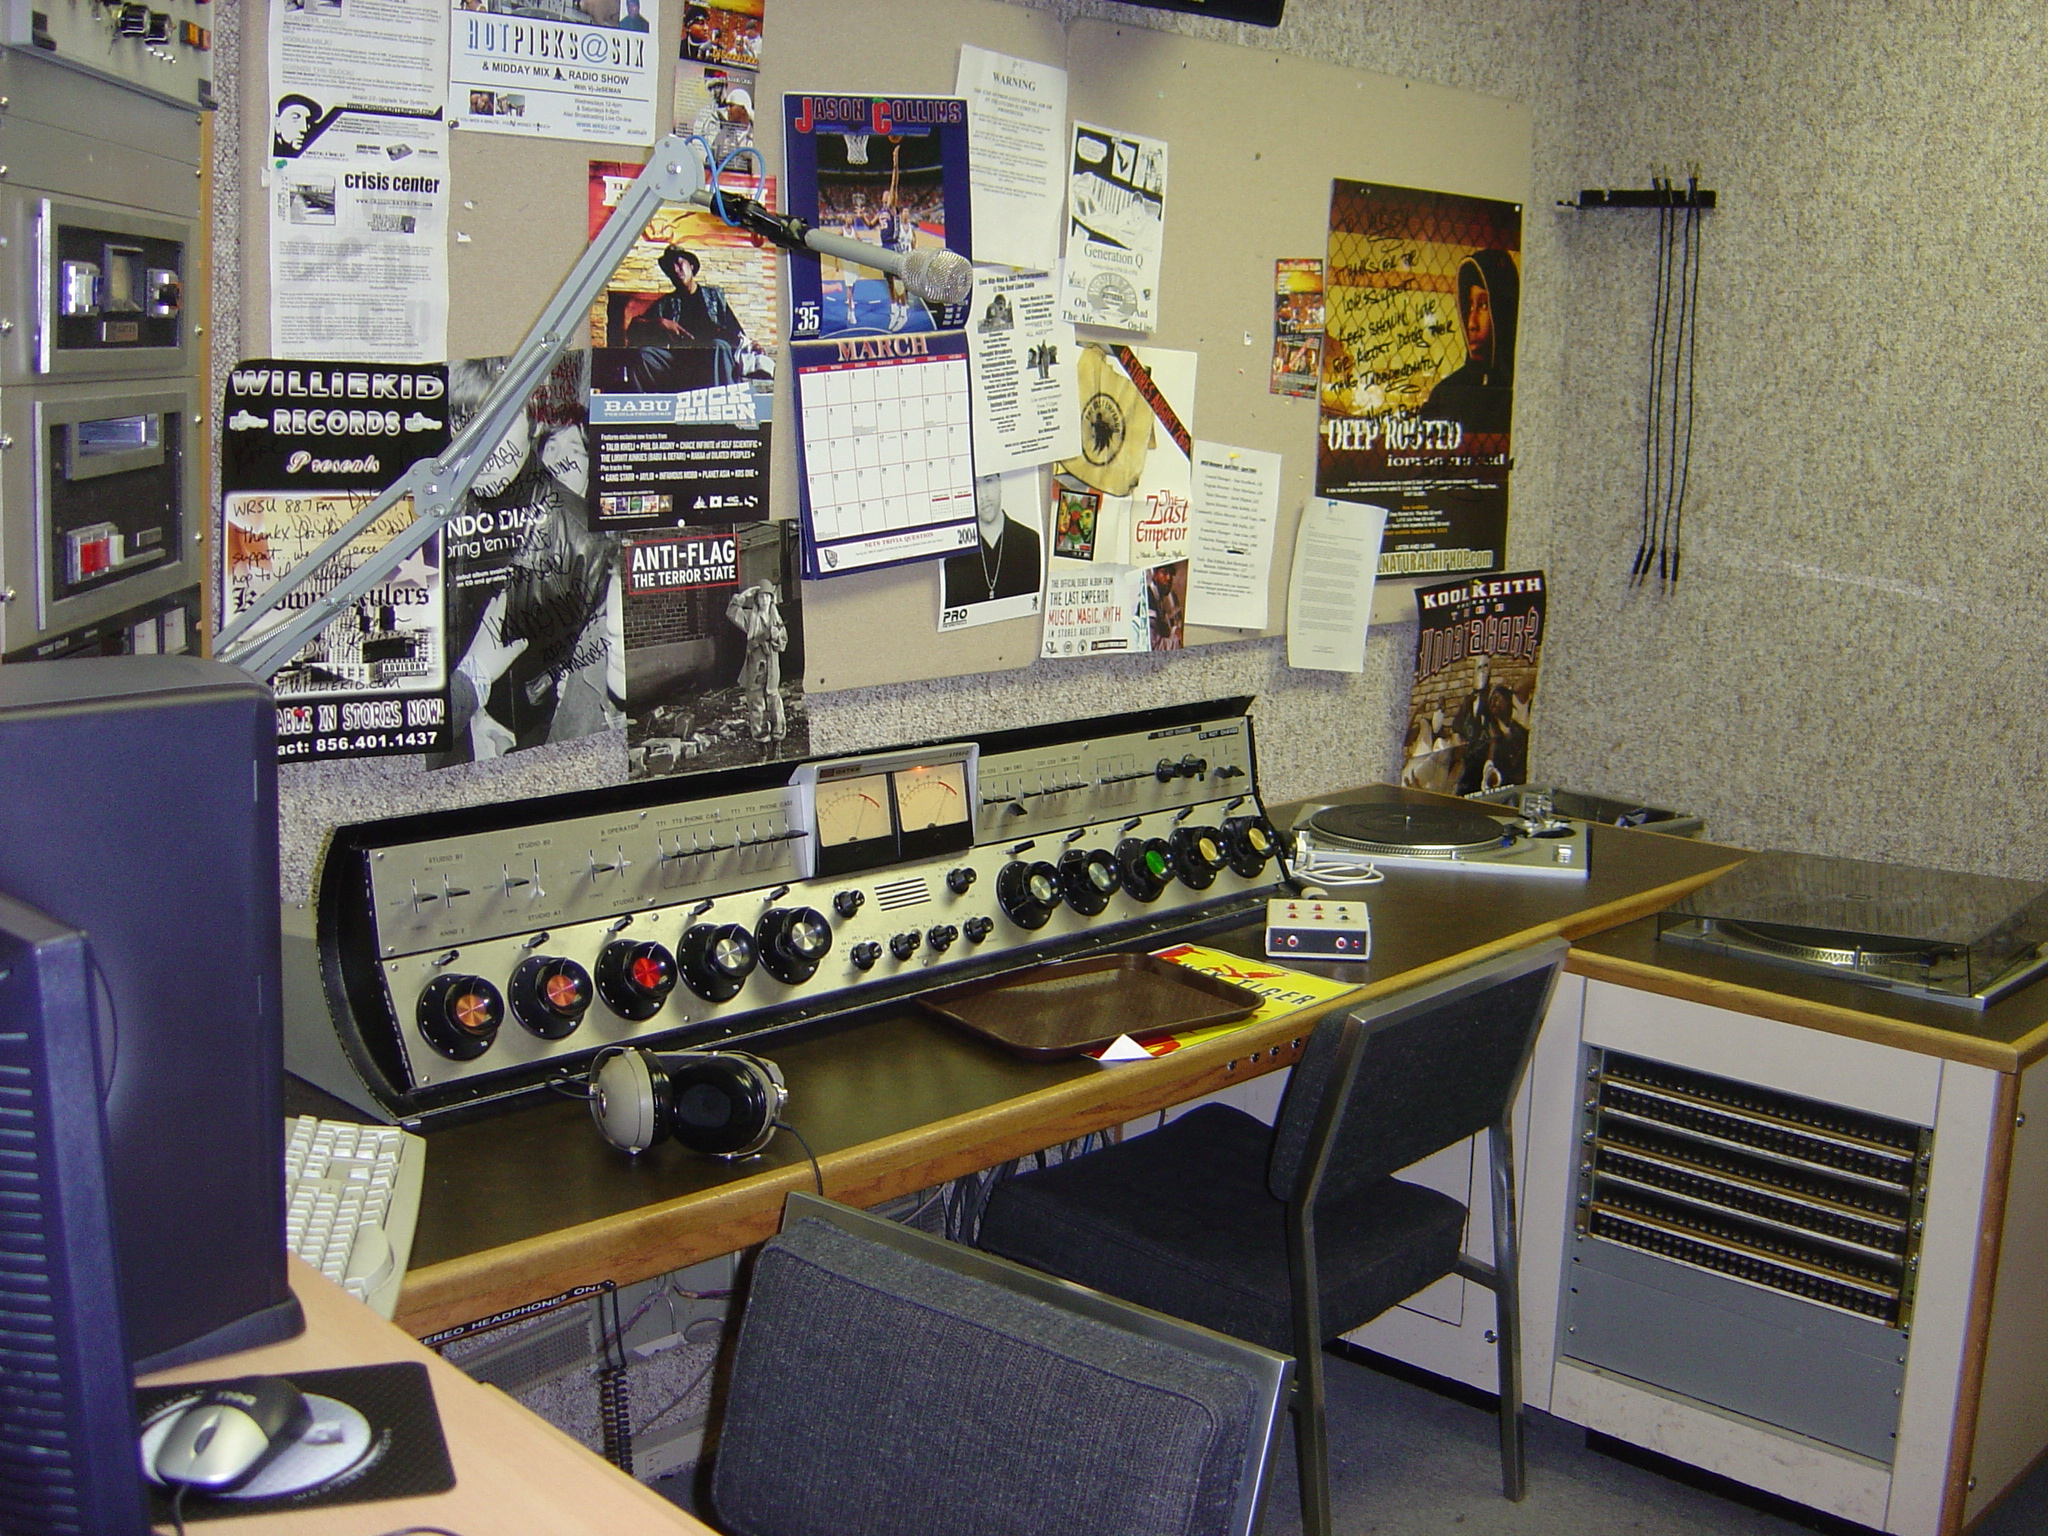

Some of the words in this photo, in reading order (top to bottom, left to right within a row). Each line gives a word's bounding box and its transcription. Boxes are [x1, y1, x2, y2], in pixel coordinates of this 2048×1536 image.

[468, 18, 645, 68] HOTPICKS@SIX
[482, 61, 489, 71] &
[492, 62, 531, 76] MIDDAY
[533, 65, 550, 77] MIX
[568, 70, 599, 82] RADIO
[601, 73, 629, 85] SHOW
[993, 71, 1036, 92] WARNING
[795, 97, 865, 134] JASON
[872, 97, 962, 135] COLLINS
[344, 171, 389, 192] crisis
[392, 174, 440, 194] center
[1083, 243, 1133, 265] Generation
[1135, 253, 1143, 268] Q
[1074, 297, 1087, 308] On
[1133, 309, 1148, 318] And
[1062, 311, 1078, 321] The
[837, 336, 930, 363] MARCH
[232, 370, 444, 400] WILLIEKID
[676, 382, 752, 410] DUCK
[604, 399, 672, 412] BABU
[675, 402, 756, 422] SEASON
[1151, 394, 1178, 433] AUGUST
[273, 408, 401, 436] RECORDS
[1327, 417, 1379, 451] DEEP
[233, 499, 277, 517] WRSU
[285, 499, 312, 513] 88.7
[1145, 495, 1189, 525] Last
[904, 531, 934, 544] QUESTION
[1136, 520, 1188, 550] Emperor
[632, 539, 736, 573] ANTI-FLAG
[633, 572, 656, 588] THE
[658, 568, 701, 586] TERROR
[703, 565, 736, 582] STATE
[1050, 592, 1063, 606] THE
[1064, 591, 1080, 606] LAST
[1081, 589, 1110, 605] EMPEROR
[1422, 586, 1470, 610] KOOL
[1471, 577, 1543, 599] KEITH
[943, 608, 968, 623] PRO
[1048, 608, 1075, 626] MUSIC,
[1077, 607, 1101, 624] MAGIC,
[1102, 605, 1122, 623] MYTH
[1058, 627, 1077, 637] STORES
[1079, 626, 1097, 636] AUGUST
[383, 662, 427, 672] ADVISORY
[318, 703, 338, 732] IN
[342, 699, 403, 731] STORES
[406, 697, 446, 728] NOW!
[316, 730, 439, 752] 856.401.1437
[607, 824, 640, 836] OPERATOR
[1235, 979, 1317, 1005] TIGER
[471, 1293, 567, 1330] HEADPHONES
